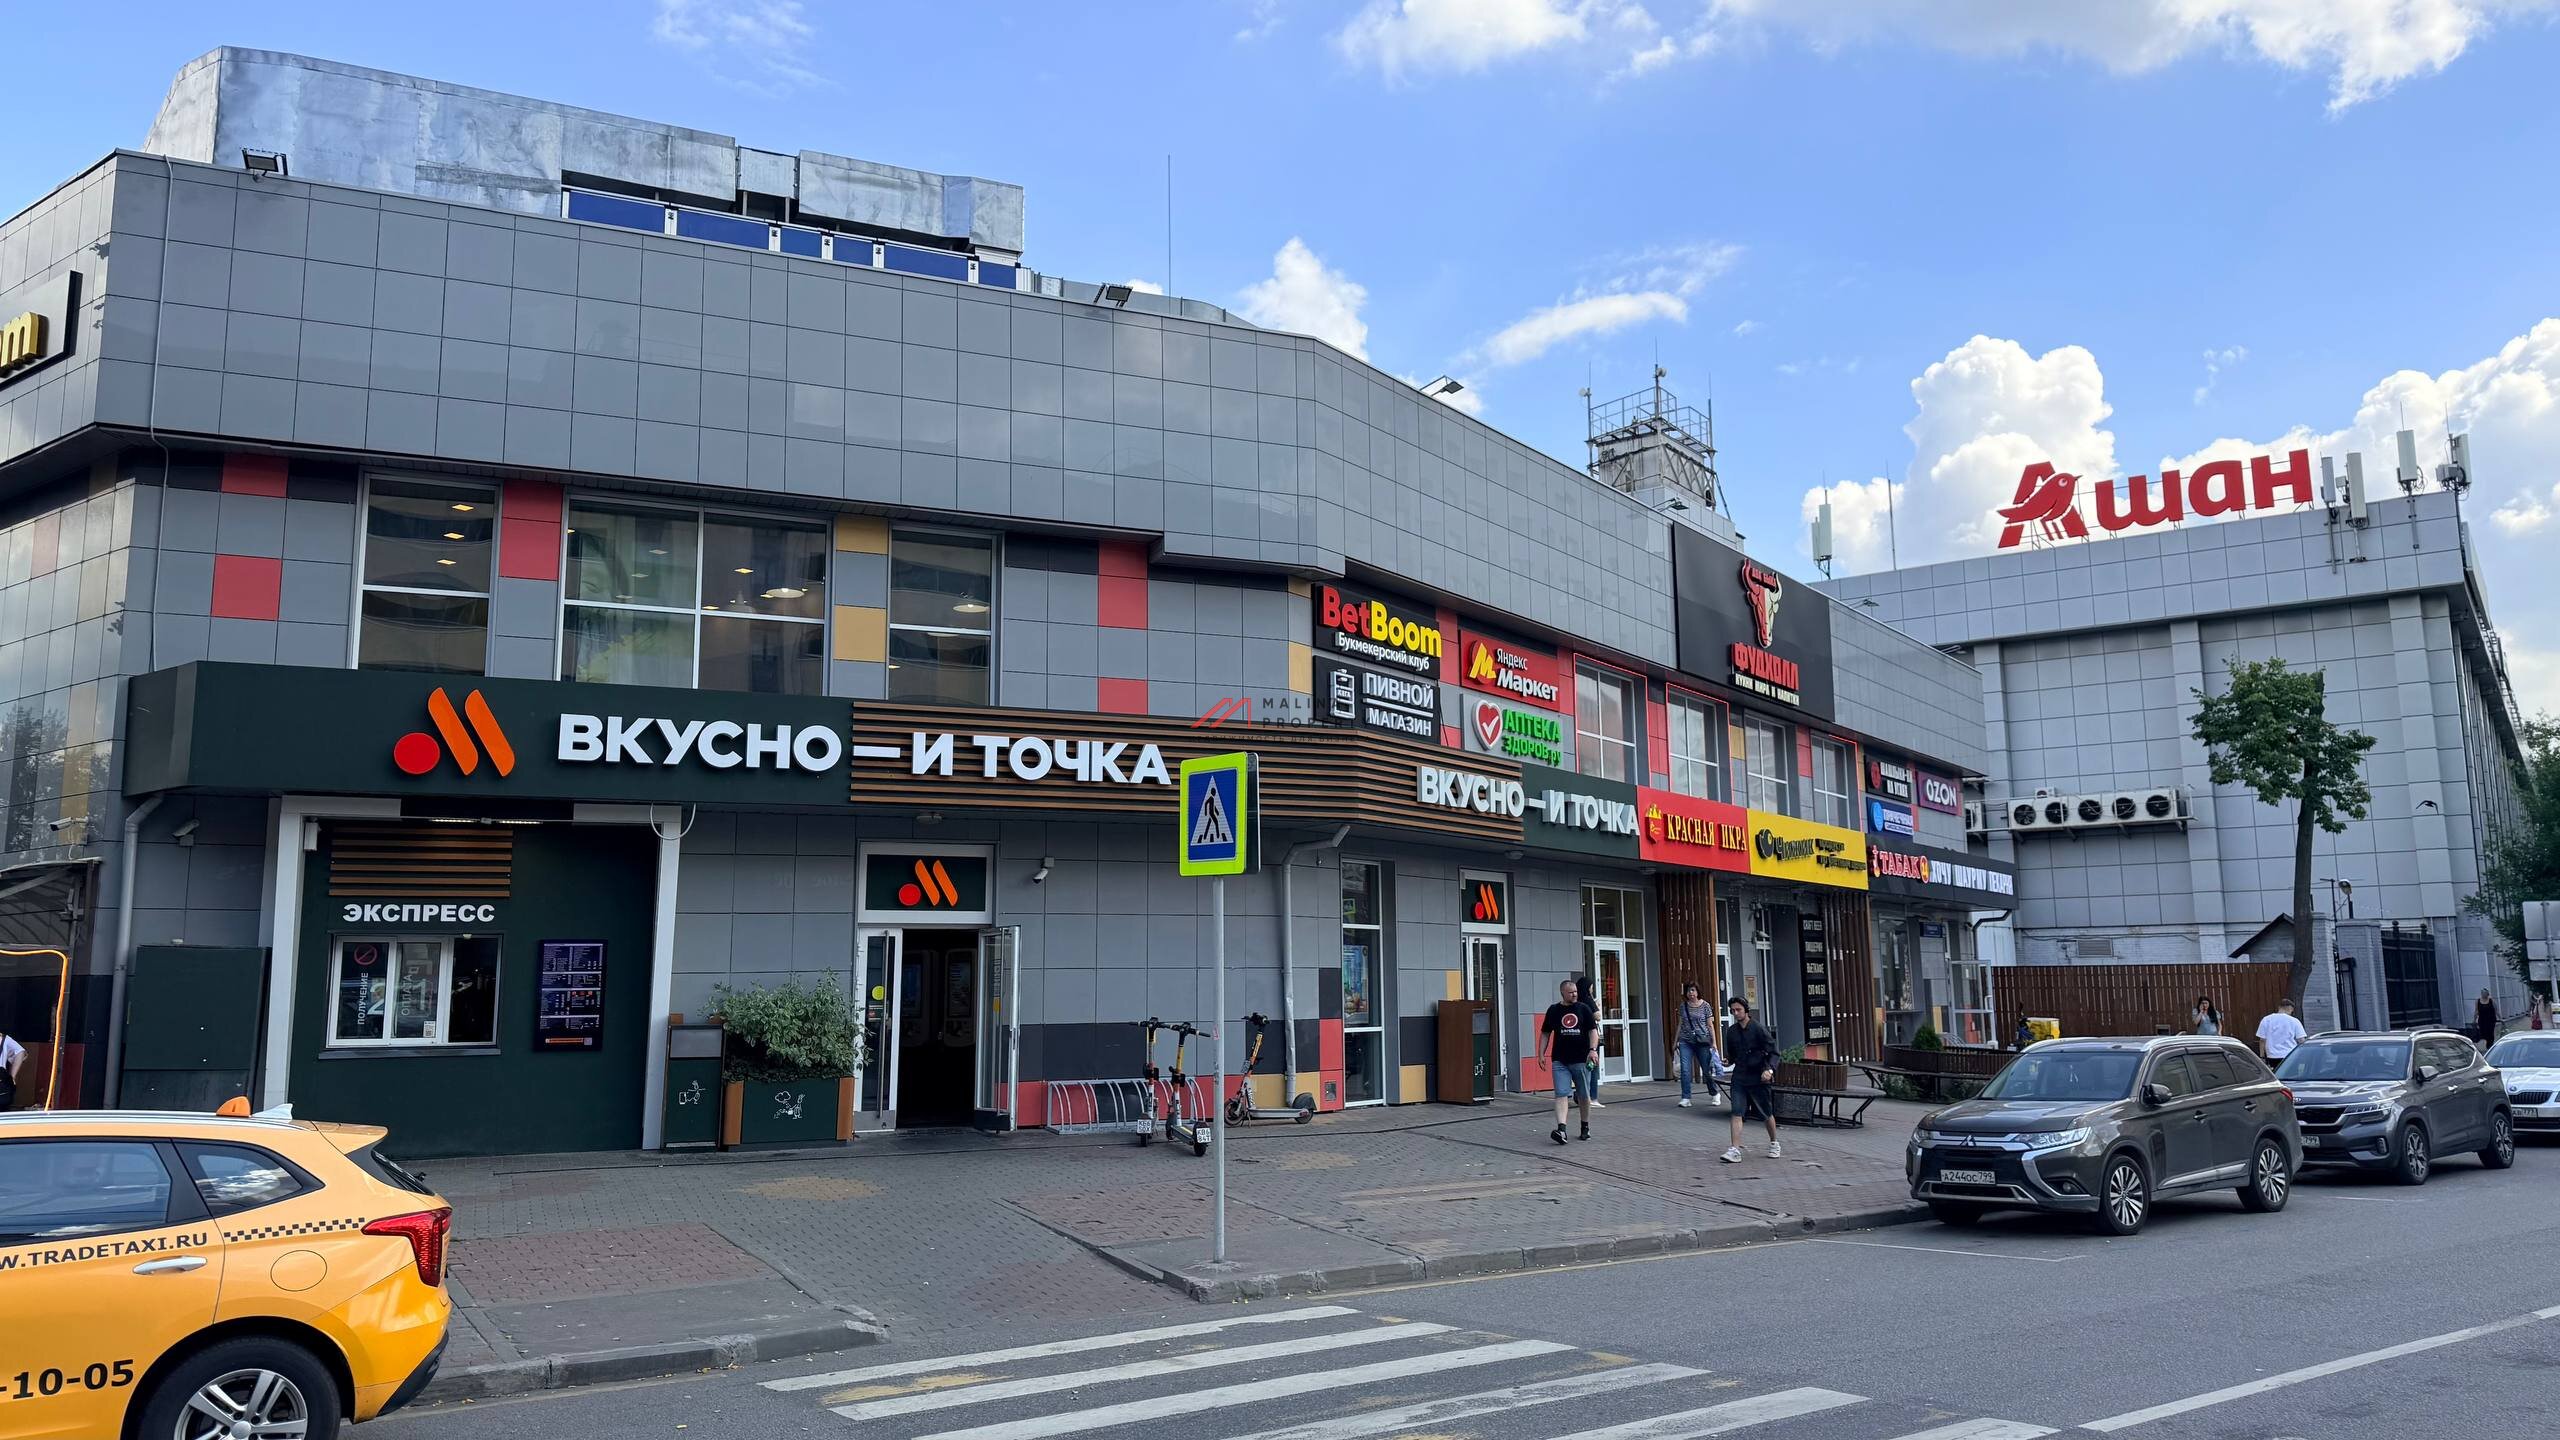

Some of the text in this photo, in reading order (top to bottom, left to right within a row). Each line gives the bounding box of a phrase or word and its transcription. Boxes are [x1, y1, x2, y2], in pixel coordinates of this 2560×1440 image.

[0, 311, 38, 368] m
[1997, 449, 2313, 548] Ашан
[1323, 585, 1442, 657] BetBoom
[1337, 632, 1430, 671] Букмекерский клуб
[1497, 648, 1528, 670] Яндекс
[1732, 642, 1799, 690] ФУДХОЛЛ
[1363, 672, 1434, 709] ПИВНОЙ
[1497, 668, 1558, 701] Маркет
[1366, 708, 1432, 737] МАГАЗИН
[1503, 708, 1560, 742] АПТЕКА
[557, 713, 842, 774] ВКУСНО
[973, 734, 1172, 786] ТОЧКА
[1417, 766, 1525, 818] ВКУСНО
[1568, 793, 1640, 836] ТОЧКА
[1925, 779, 1957, 807] OZON
[1667, 813, 1748, 852] КРАСНАЯ ИКРА
[1879, 850, 1921, 880] ТАБАК
[1930, 859, 1951, 886] ХОЧУ
[1953, 864, 1987, 891] ШАУРМУ
[342, 903, 495, 923] ЭКСПРЕСС
[357, 972, 369, 1025] ПОЛУЧЕНИЕ
[401, 974, 413, 1016] ОПЛАТА
